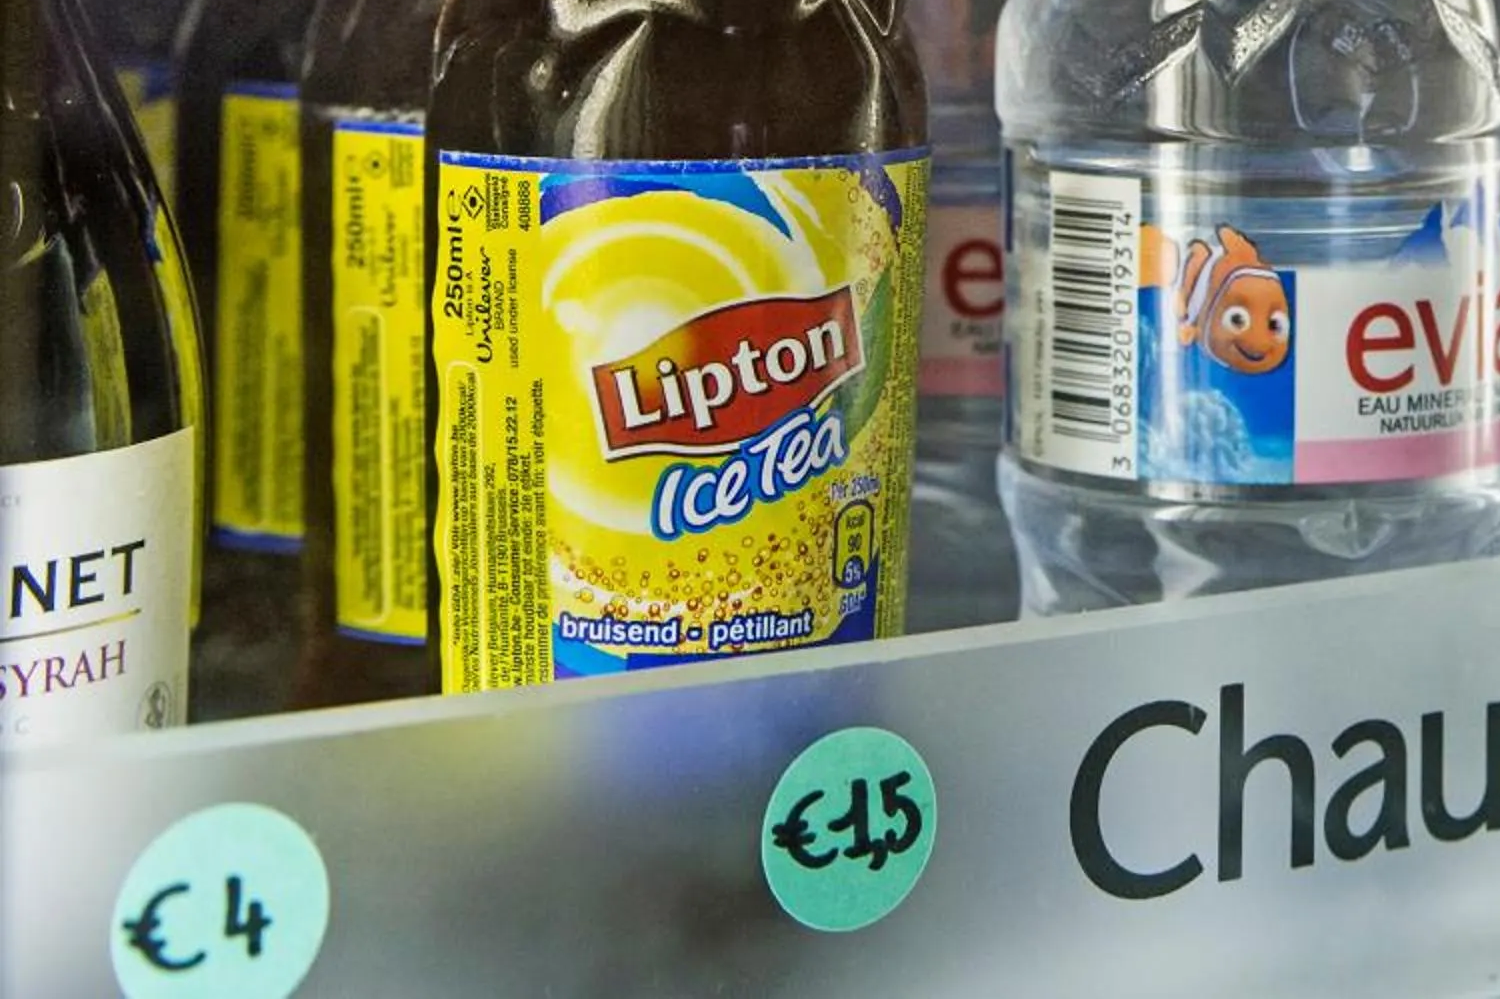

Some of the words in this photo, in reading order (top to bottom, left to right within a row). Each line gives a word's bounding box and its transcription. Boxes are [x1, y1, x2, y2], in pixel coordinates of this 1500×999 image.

[444, 226, 463, 318] 250ml
[507, 249, 517, 293] license
[1111, 211, 1133, 315] 019314
[475, 246, 492, 363] Unilever
[494, 281, 504, 330] BRAND
[508, 297, 518, 334] under
[508, 338, 519, 368] used
[614, 317, 846, 430] Lipton
[1111, 329, 1132, 435] 068320
[1358, 395, 1401, 416] EAU
[657, 459, 749, 534] Ice
[749, 412, 845, 497] Tea
[1112, 456, 1131, 471] 3
[9, 538, 146, 620] NET
[522, 580, 534, 639] houdbaar
[561, 613, 679, 642] bruisend
[712, 610, 812, 646] pétillant
[771, 770, 923, 872] €1,5
